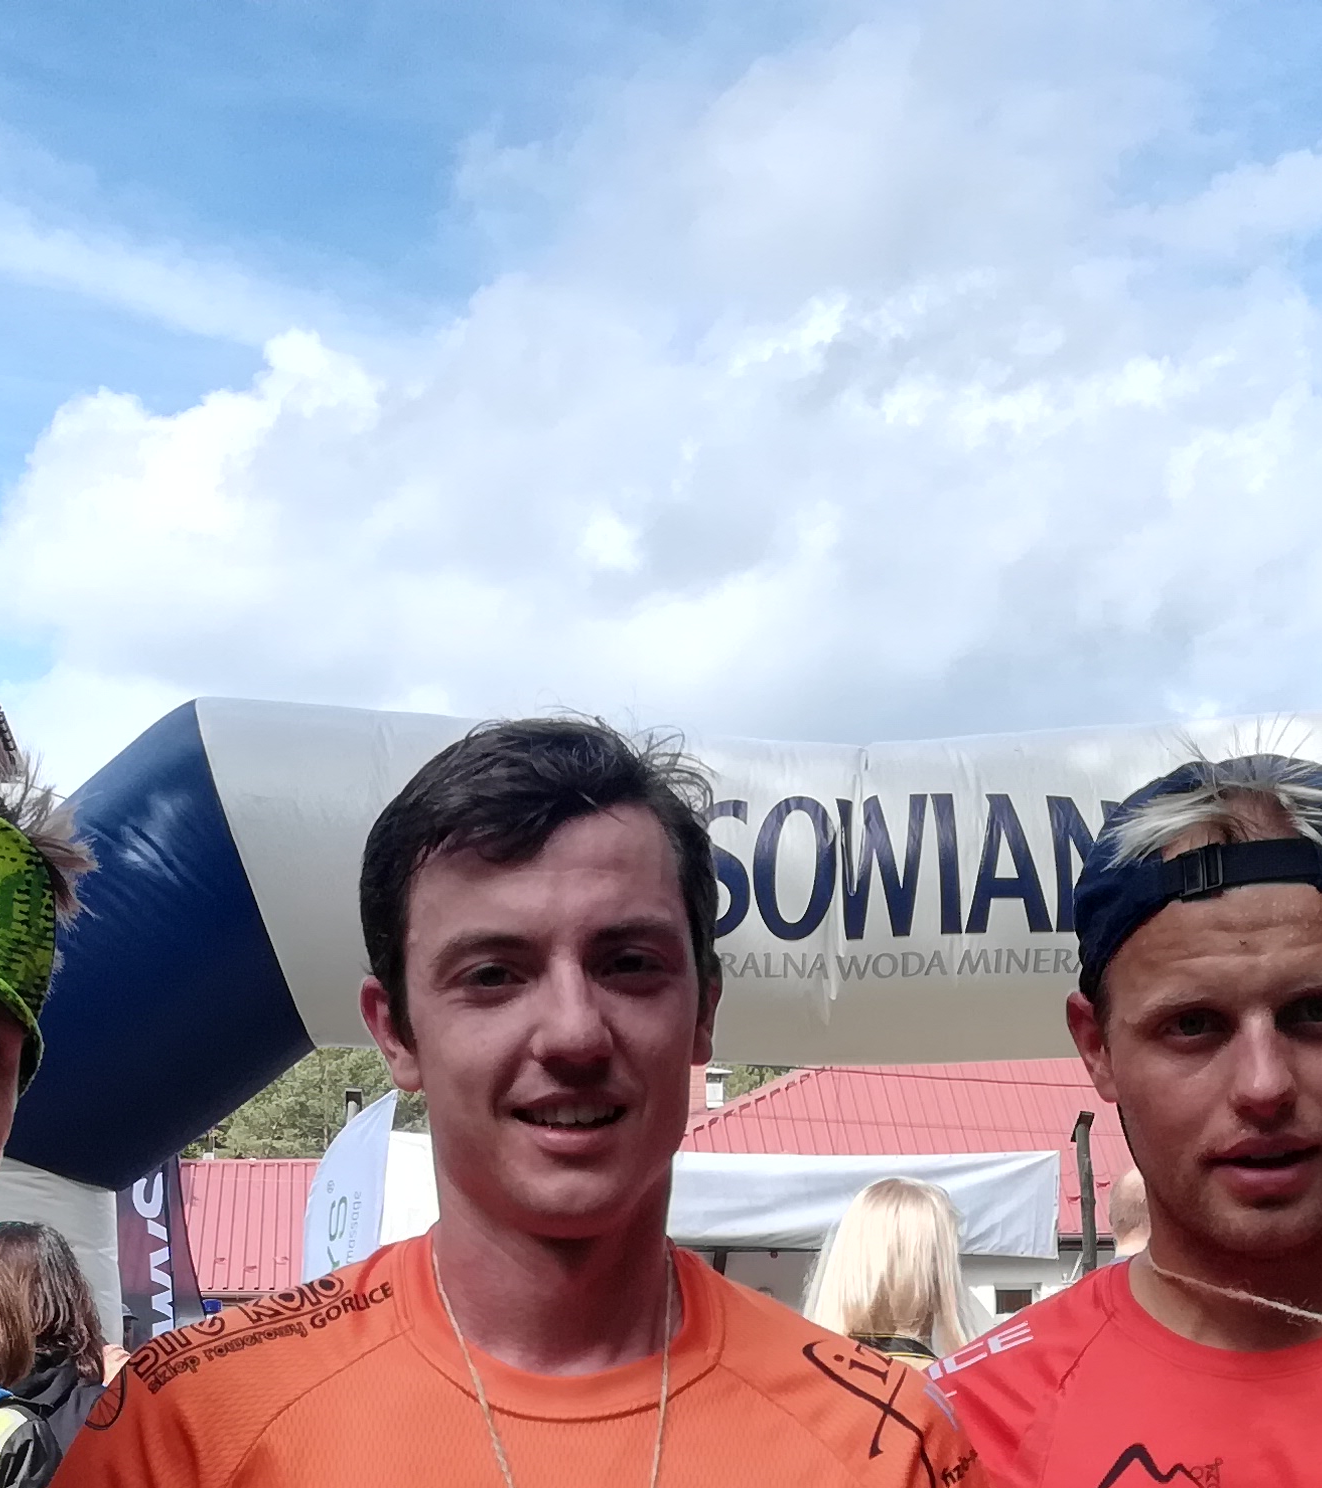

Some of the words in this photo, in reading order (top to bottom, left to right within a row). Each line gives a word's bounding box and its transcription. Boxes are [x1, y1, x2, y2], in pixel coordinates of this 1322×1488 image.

[835, 950, 947, 982] WODA
[148, 1353, 200, 1394] sklep
[205, 1321, 308, 1363] rowerowy
[310, 1281, 395, 1329] GORLICE
